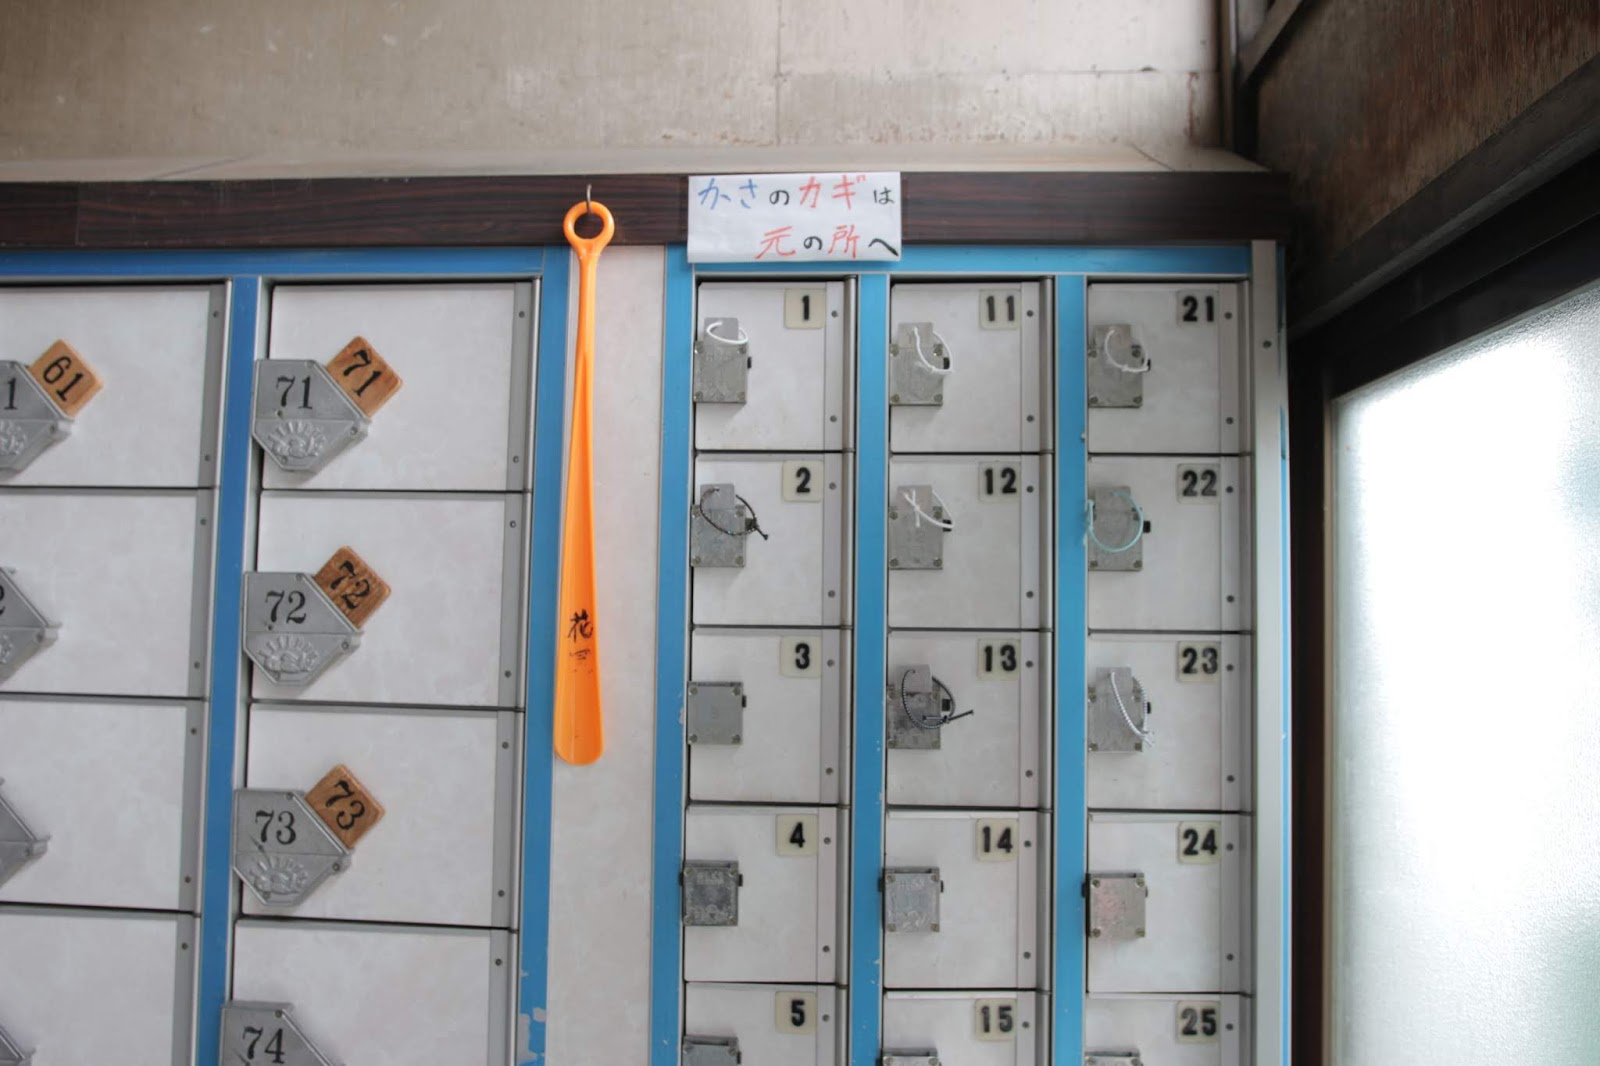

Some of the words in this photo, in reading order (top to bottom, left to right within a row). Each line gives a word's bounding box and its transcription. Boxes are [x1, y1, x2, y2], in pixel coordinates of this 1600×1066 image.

[698, 175, 894, 211] かさのカギは
[755, 225, 899, 259] 元の所へ
[801, 294, 810, 321] 1
[985, 295, 1015, 322] 11
[1182, 295, 1215, 323] 21
[42, 356, 84, 401] 61
[342, 348, 383, 398] 71
[3, 376, 17, 411] 1
[275, 375, 313, 410] 71
[795, 466, 811, 494] 2
[984, 467, 1018, 496] 12
[1181, 468, 1218, 497] 22
[329, 561, 371, 610] 72
[265, 590, 307, 625] 72
[794, 642, 811, 670] 3
[983, 644, 1017, 673] 13
[1182, 646, 1219, 675] 23
[324, 779, 366, 831] 73
[254, 809, 297, 845] 73
[789, 821, 806, 849] 4
[982, 825, 1014, 854] 14
[1183, 828, 1219, 856] 24
[790, 999, 806, 1027] 5
[980, 1004, 1014, 1034] 15
[1181, 1007, 1218, 1037] 25
[242, 1026, 286, 1065] 74
